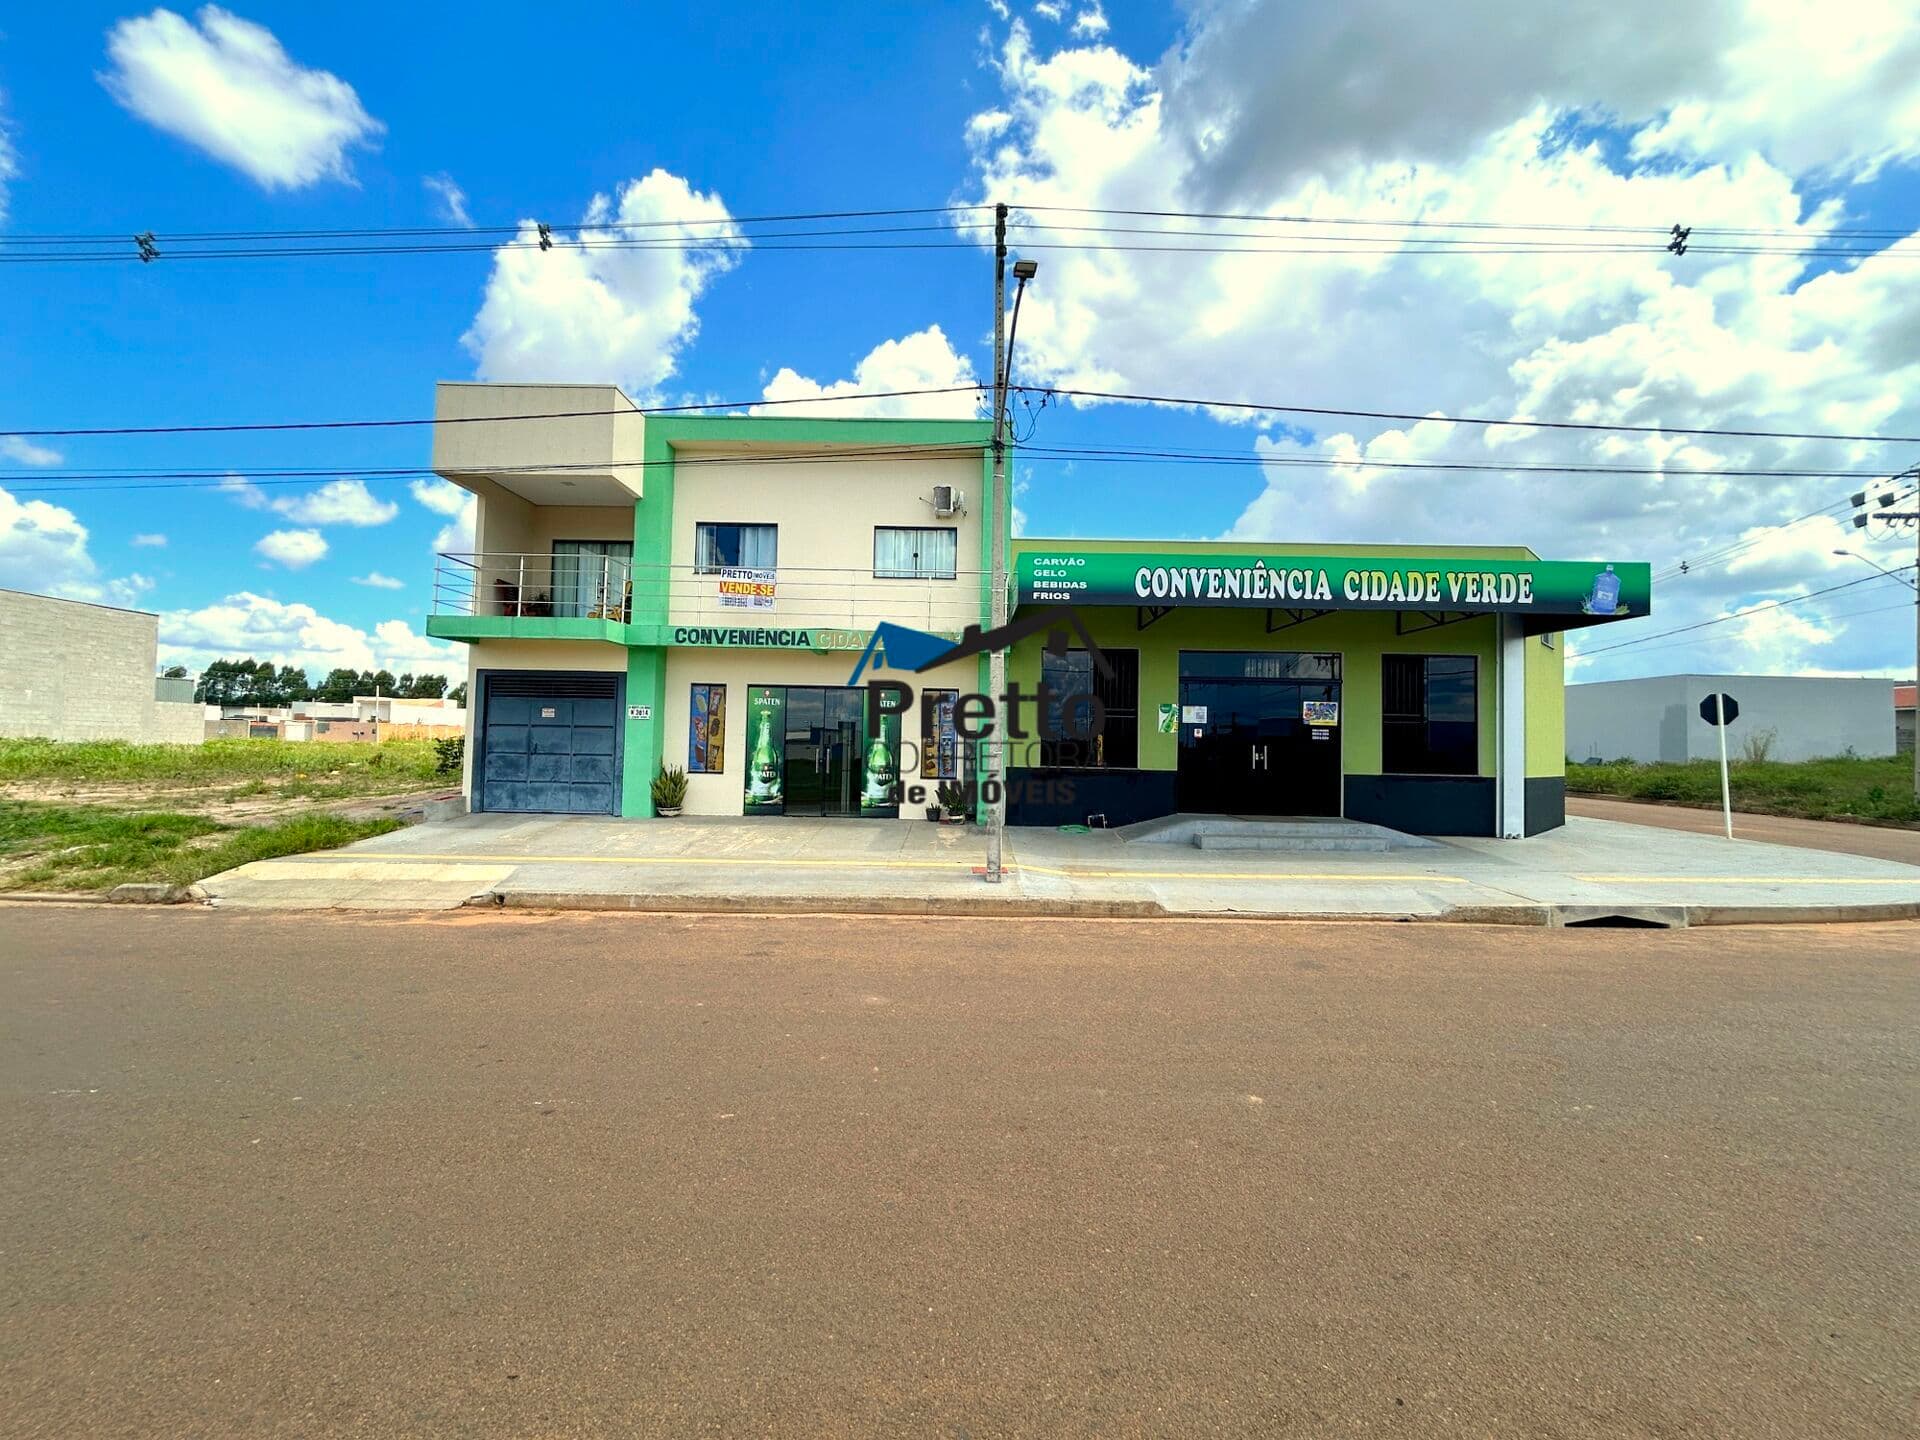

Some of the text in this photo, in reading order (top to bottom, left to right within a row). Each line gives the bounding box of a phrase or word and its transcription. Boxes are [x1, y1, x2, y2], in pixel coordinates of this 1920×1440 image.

[1033, 556, 1086, 567] CARVÃO
[722, 568, 753, 580] PRETTO
[1033, 568, 1067, 578] GELO
[1033, 580, 1088, 590] BEBIDAS
[1134, 559, 1534, 604] CONVENIÊNCIA CIDADE VERDE
[721, 582, 774, 596] VENDE-SE
[1033, 591, 1071, 600] FRIOS
[674, 628, 885, 650] CONVENIÊNCIA CIDA
[754, 697, 781, 706] SPATEN
